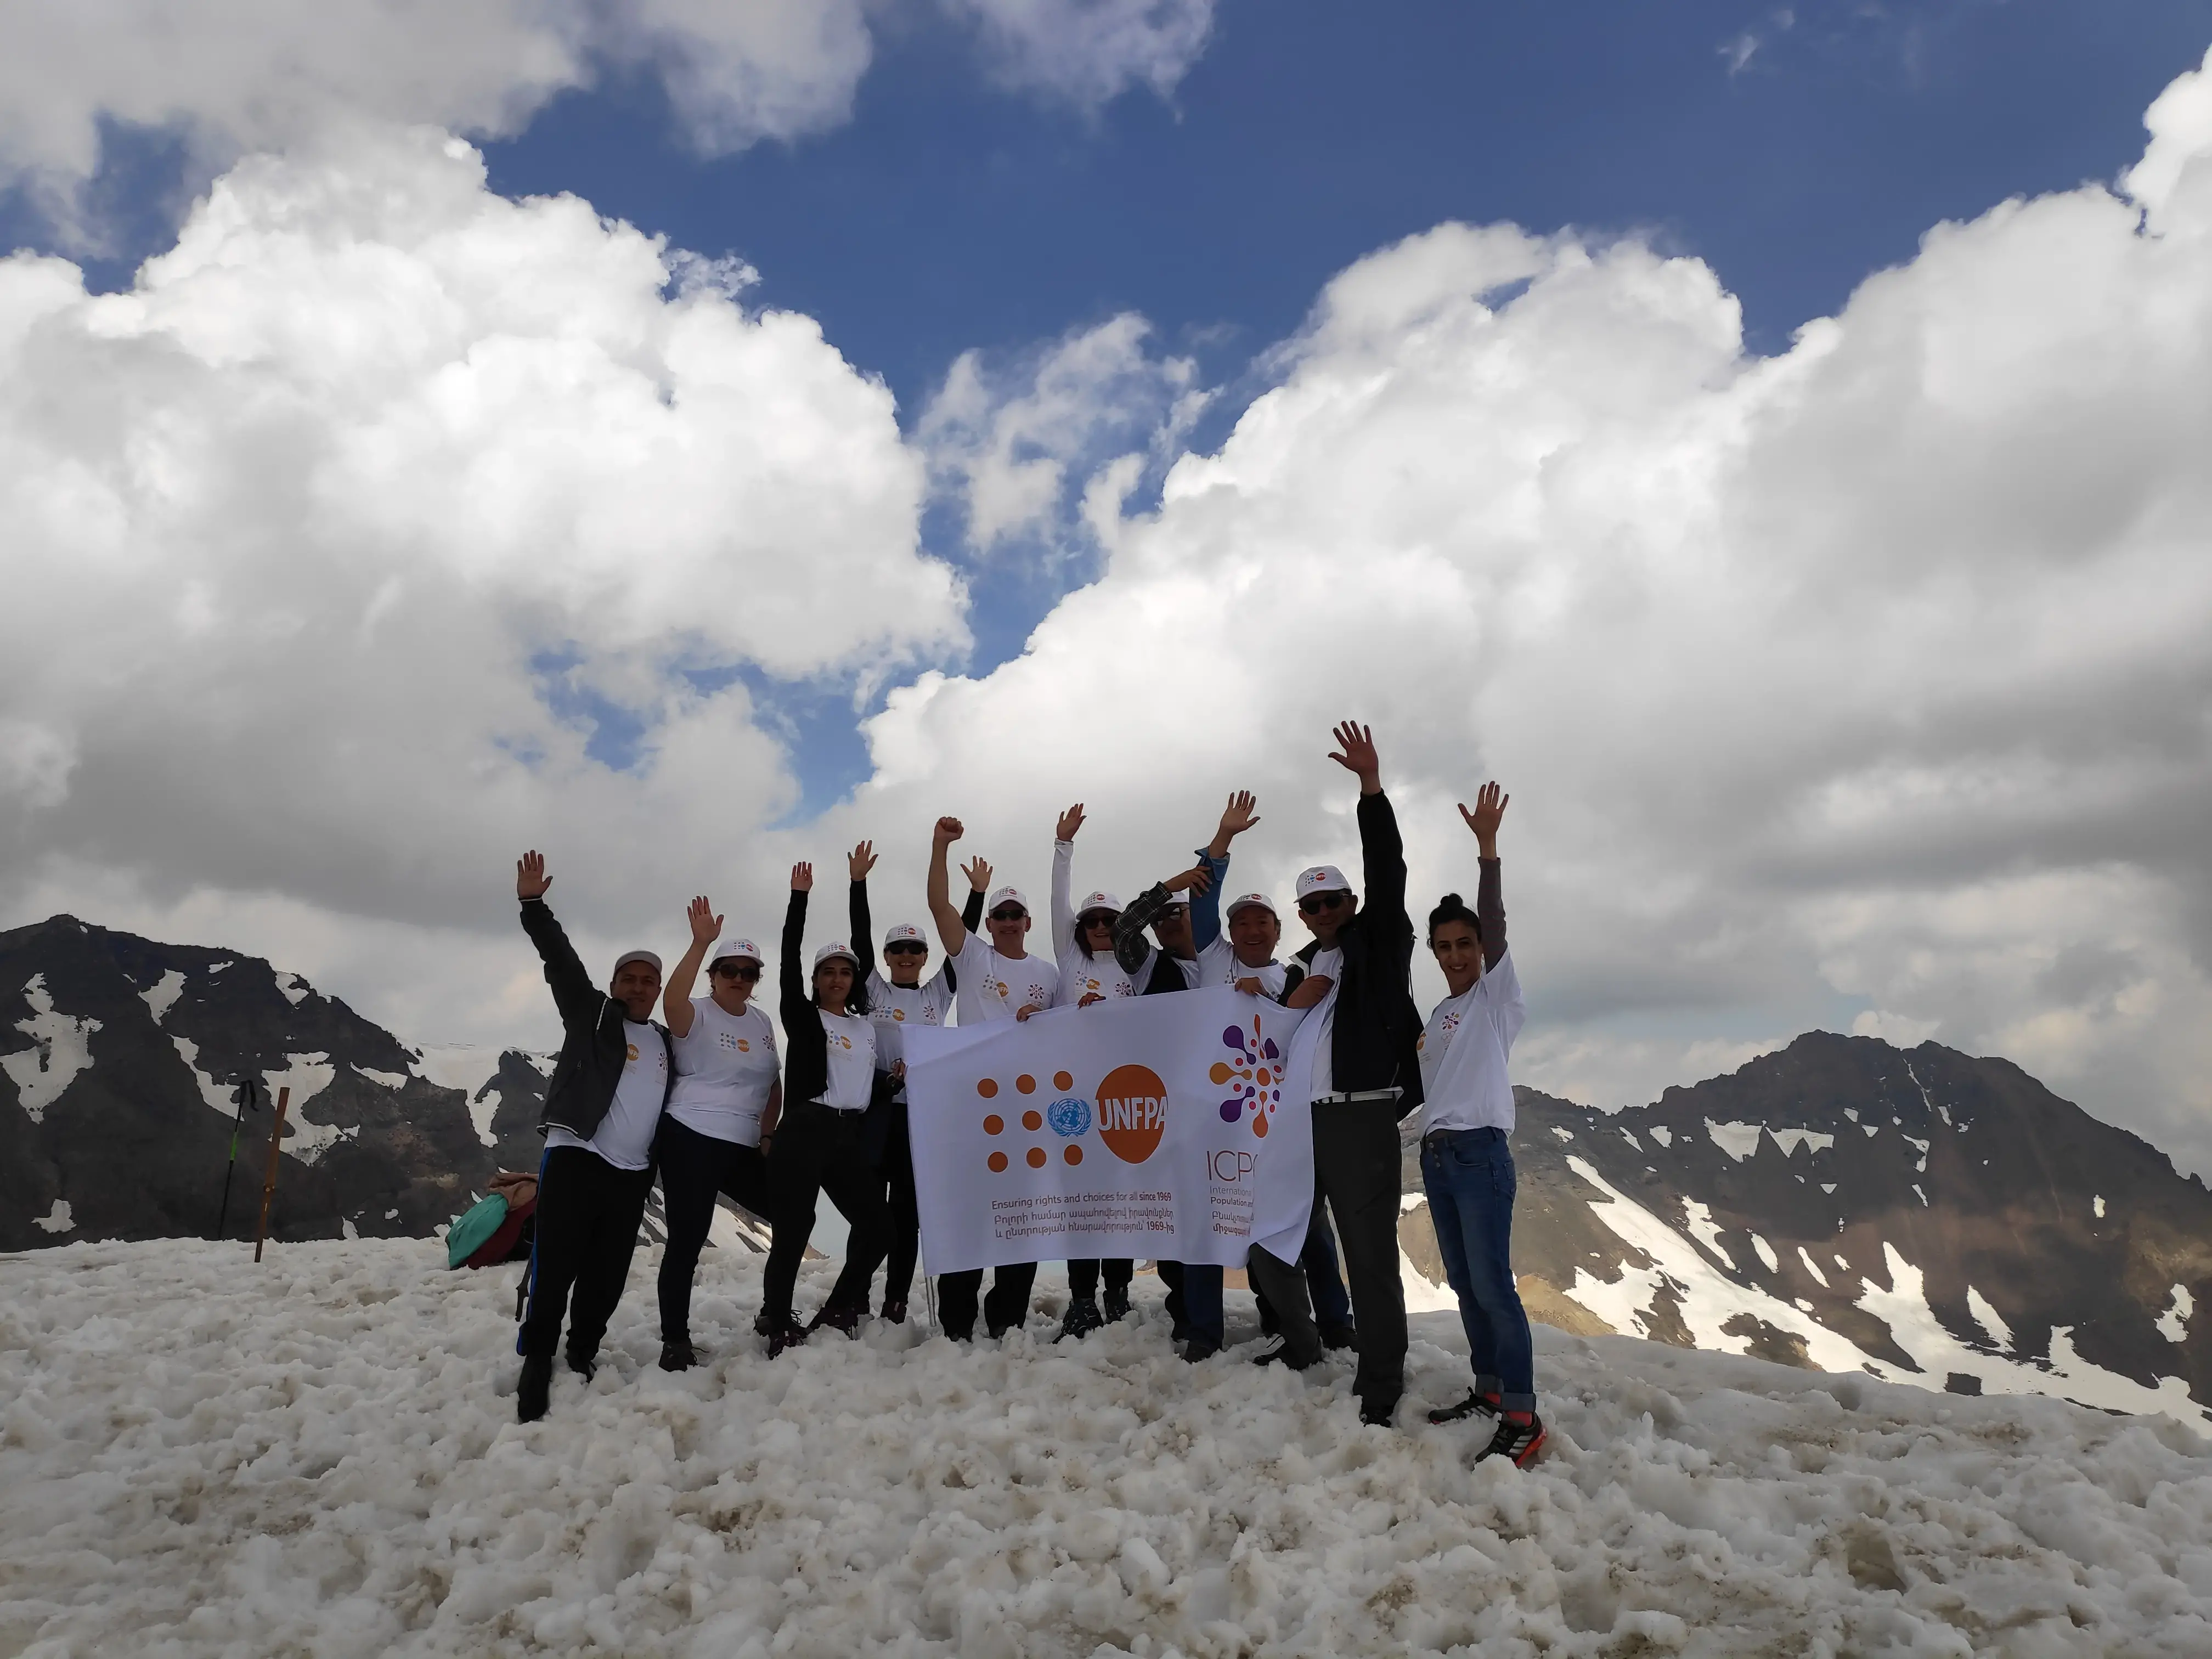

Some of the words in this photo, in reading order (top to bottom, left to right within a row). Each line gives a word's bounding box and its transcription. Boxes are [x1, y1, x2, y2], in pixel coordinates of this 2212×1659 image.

[1096, 1096, 1168, 1131] UNFPA
[1206, 1150, 1259, 1182] ICP
[991, 1198, 1032, 1210] Ensuring
[1035, 1195, 1062, 1207] rights
[1064, 1193, 1080, 1203] and
[1083, 1192, 1114, 1203] choices
[1116, 1192, 1127, 1201] for
[1129, 1191, 1138, 1201] all
[1139, 1192, 1156, 1201] since
[1156, 1192, 1172, 1201] 1969
[1210, 1197, 1247, 1207] Population
[994, 1212, 1029, 1226] Բոլորի
[1031, 1209, 1066, 1221] համար
[1128, 1206, 1174, 1221] իրավունքներ
[995, 1228, 1003, 1238] և
[1006, 1223, 1065, 1240] ընտրության
[1146, 1220, 1175, 1234] 1969-ից
